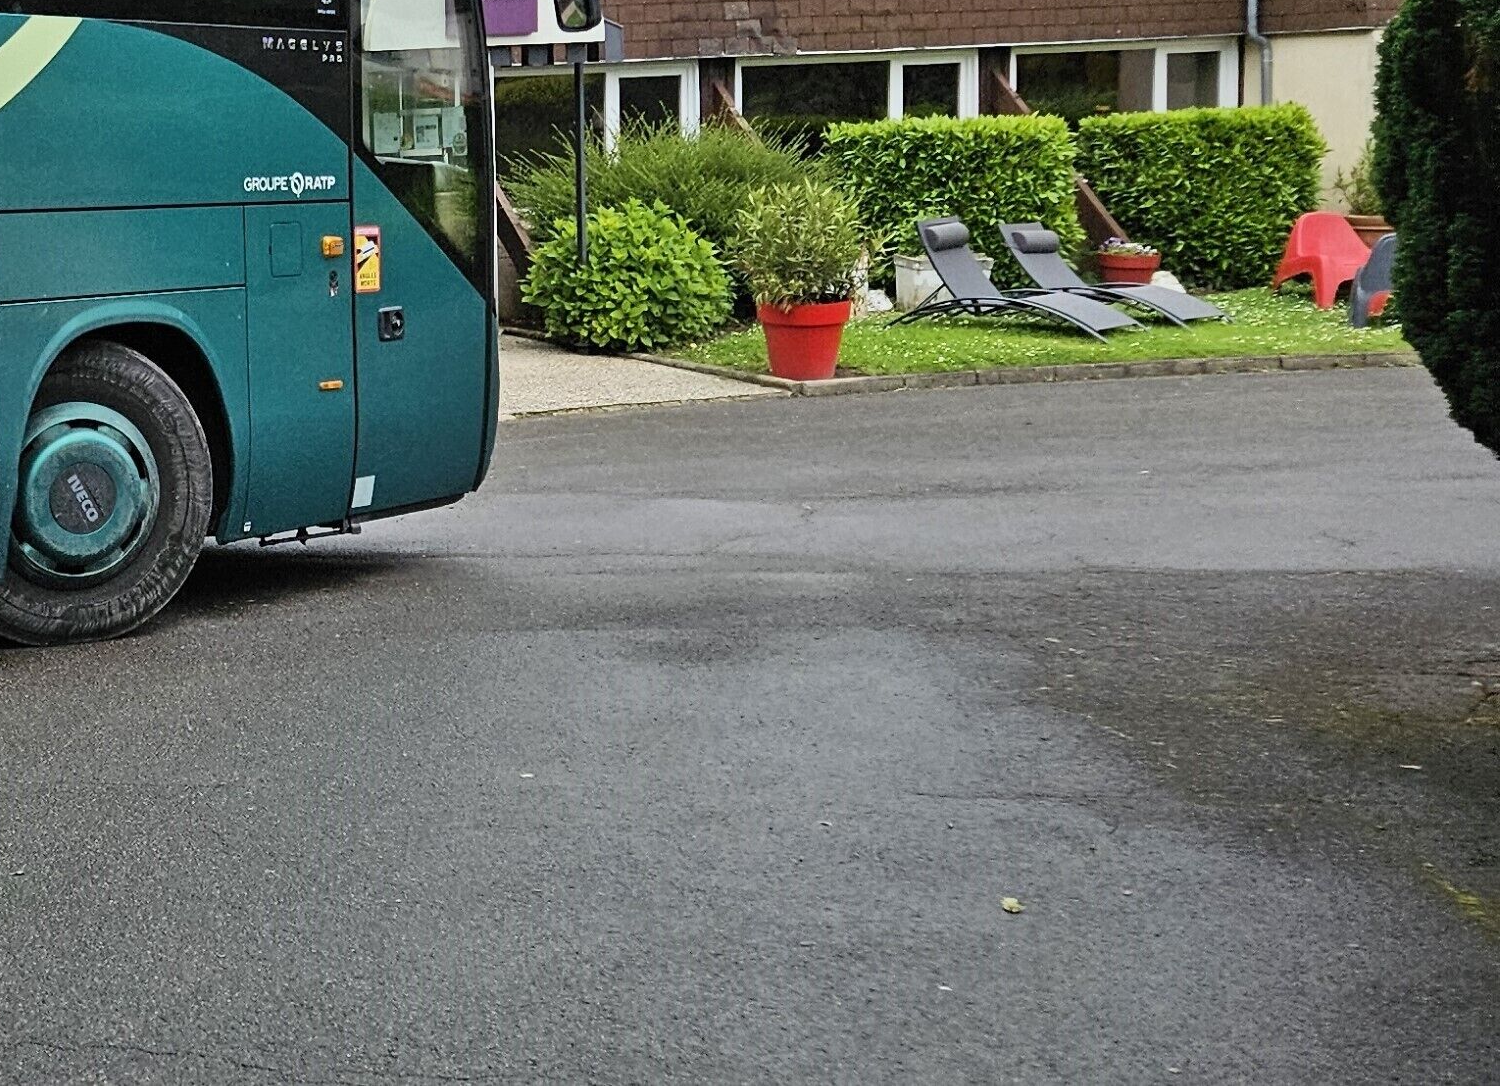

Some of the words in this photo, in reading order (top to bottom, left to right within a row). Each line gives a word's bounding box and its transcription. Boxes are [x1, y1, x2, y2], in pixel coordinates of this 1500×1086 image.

[262, 36, 343, 52] MAGELYS
[243, 176, 289, 192] GROUPE
[304, 175, 336, 190] RATP
[67, 474, 99, 522] IVECO
